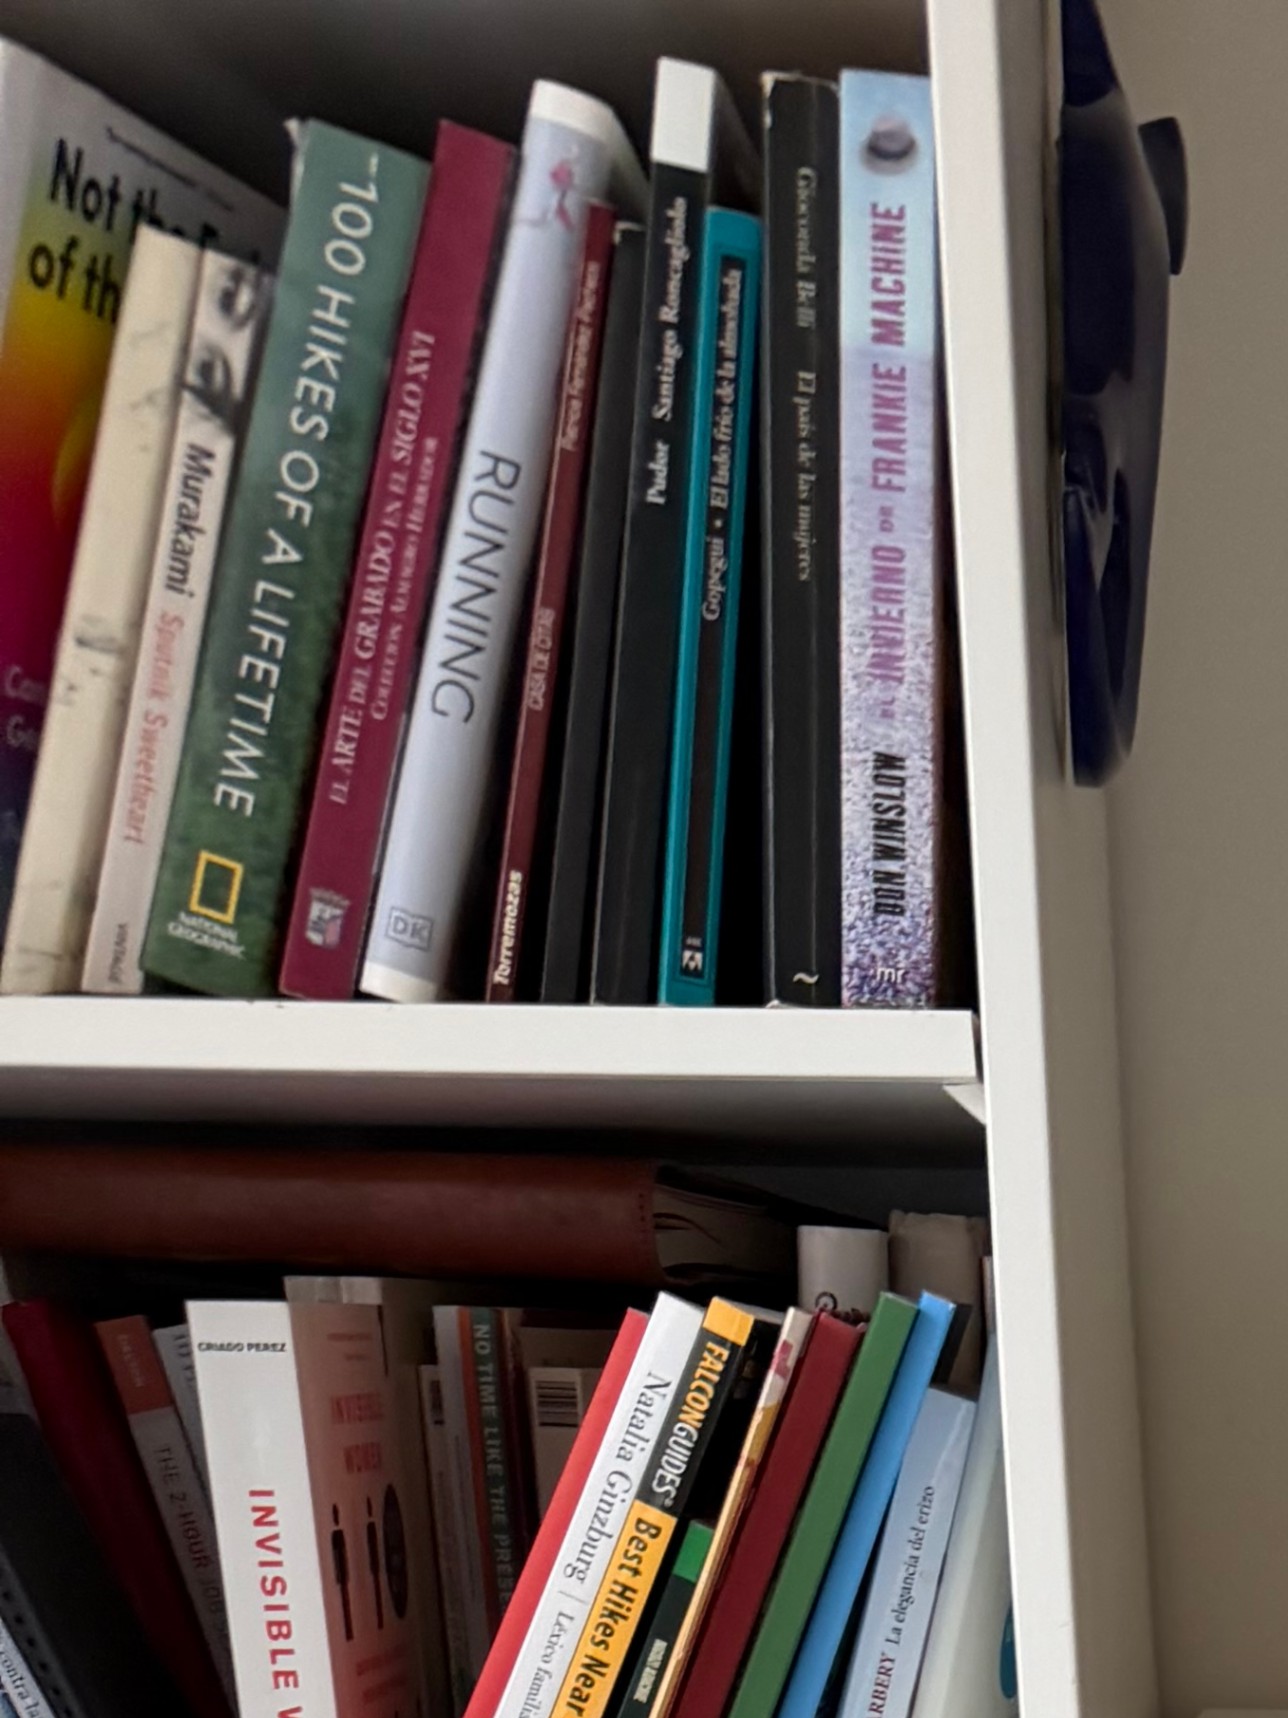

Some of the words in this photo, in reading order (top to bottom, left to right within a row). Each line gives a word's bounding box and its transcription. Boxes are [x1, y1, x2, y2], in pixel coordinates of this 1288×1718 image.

[51, 137, 121, 232] Not
[28, 236, 78, 299] of
[323, 181, 379, 276] 100
[870, 202, 907, 348] MACHINE
[288, 284, 356, 442] HIKES
[404, 328, 437, 381] XVI
[651, 329, 683, 423] Santiago
[390, 381, 424, 467] SIGLO
[871, 362, 908, 494] FRANKIE
[275, 449, 321, 527] OF
[646, 439, 671, 505] Pudor
[710, 485, 729, 510] El
[164, 442, 216, 599] Murakami
[261, 527, 303, 565] A
[354, 530, 396, 661] GRABADO
[430, 449, 522, 726] RUNNING
[867, 544, 907, 685] INVIERNO
[213, 579, 296, 818] LIFETIME
[331, 706, 364, 773] ARTE
[871, 750, 907, 862] WINSLOW
[391, 915, 431, 944] DK
[492, 869, 523, 986] Torremozas
[871, 869, 906, 917] DON
[473, 1324, 491, 1354] NO
[477, 1362, 496, 1416] TIME
[615, 1372, 671, 1461] Natalia
[652, 1342, 728, 1495] FALCONGUIDES
[483, 1426, 503, 1475] LIKE
[565, 1469, 630, 1582] Ginzburg
[907, 1526, 926, 1551] del
[917, 1485, 934, 1525] erizo
[617, 1517, 662, 1576] Best
[249, 1489, 298, 1688] INVISIBLE
[590, 1579, 638, 1650] Hikes
[890, 1554, 920, 1623] elegancia
[884, 1626, 903, 1645] La
[566, 1654, 609, 1717] Near
